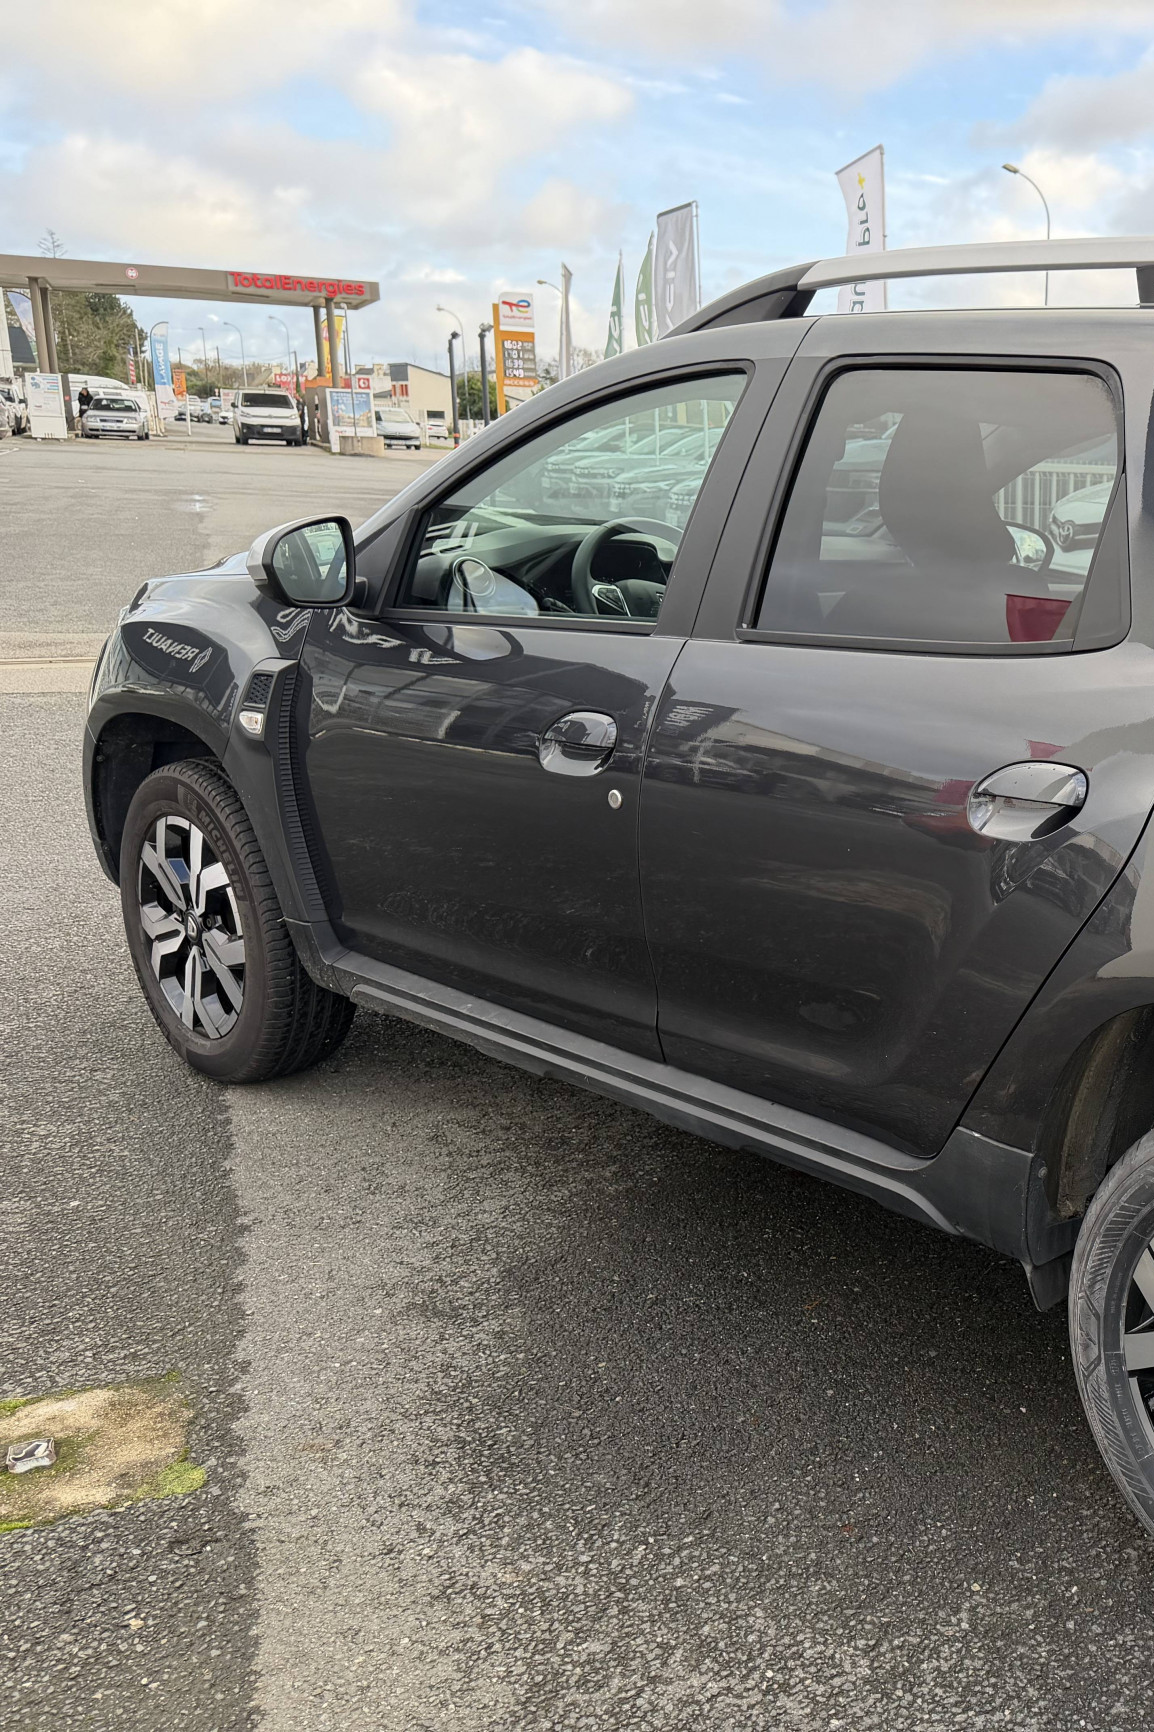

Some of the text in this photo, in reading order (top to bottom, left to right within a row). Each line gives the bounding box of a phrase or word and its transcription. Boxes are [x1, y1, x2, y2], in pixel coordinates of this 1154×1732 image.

[228, 272, 365, 297] TotalEnergies
[155, 342, 168, 385] LAVAGE
[196, 810, 245, 898] MICHELIN
